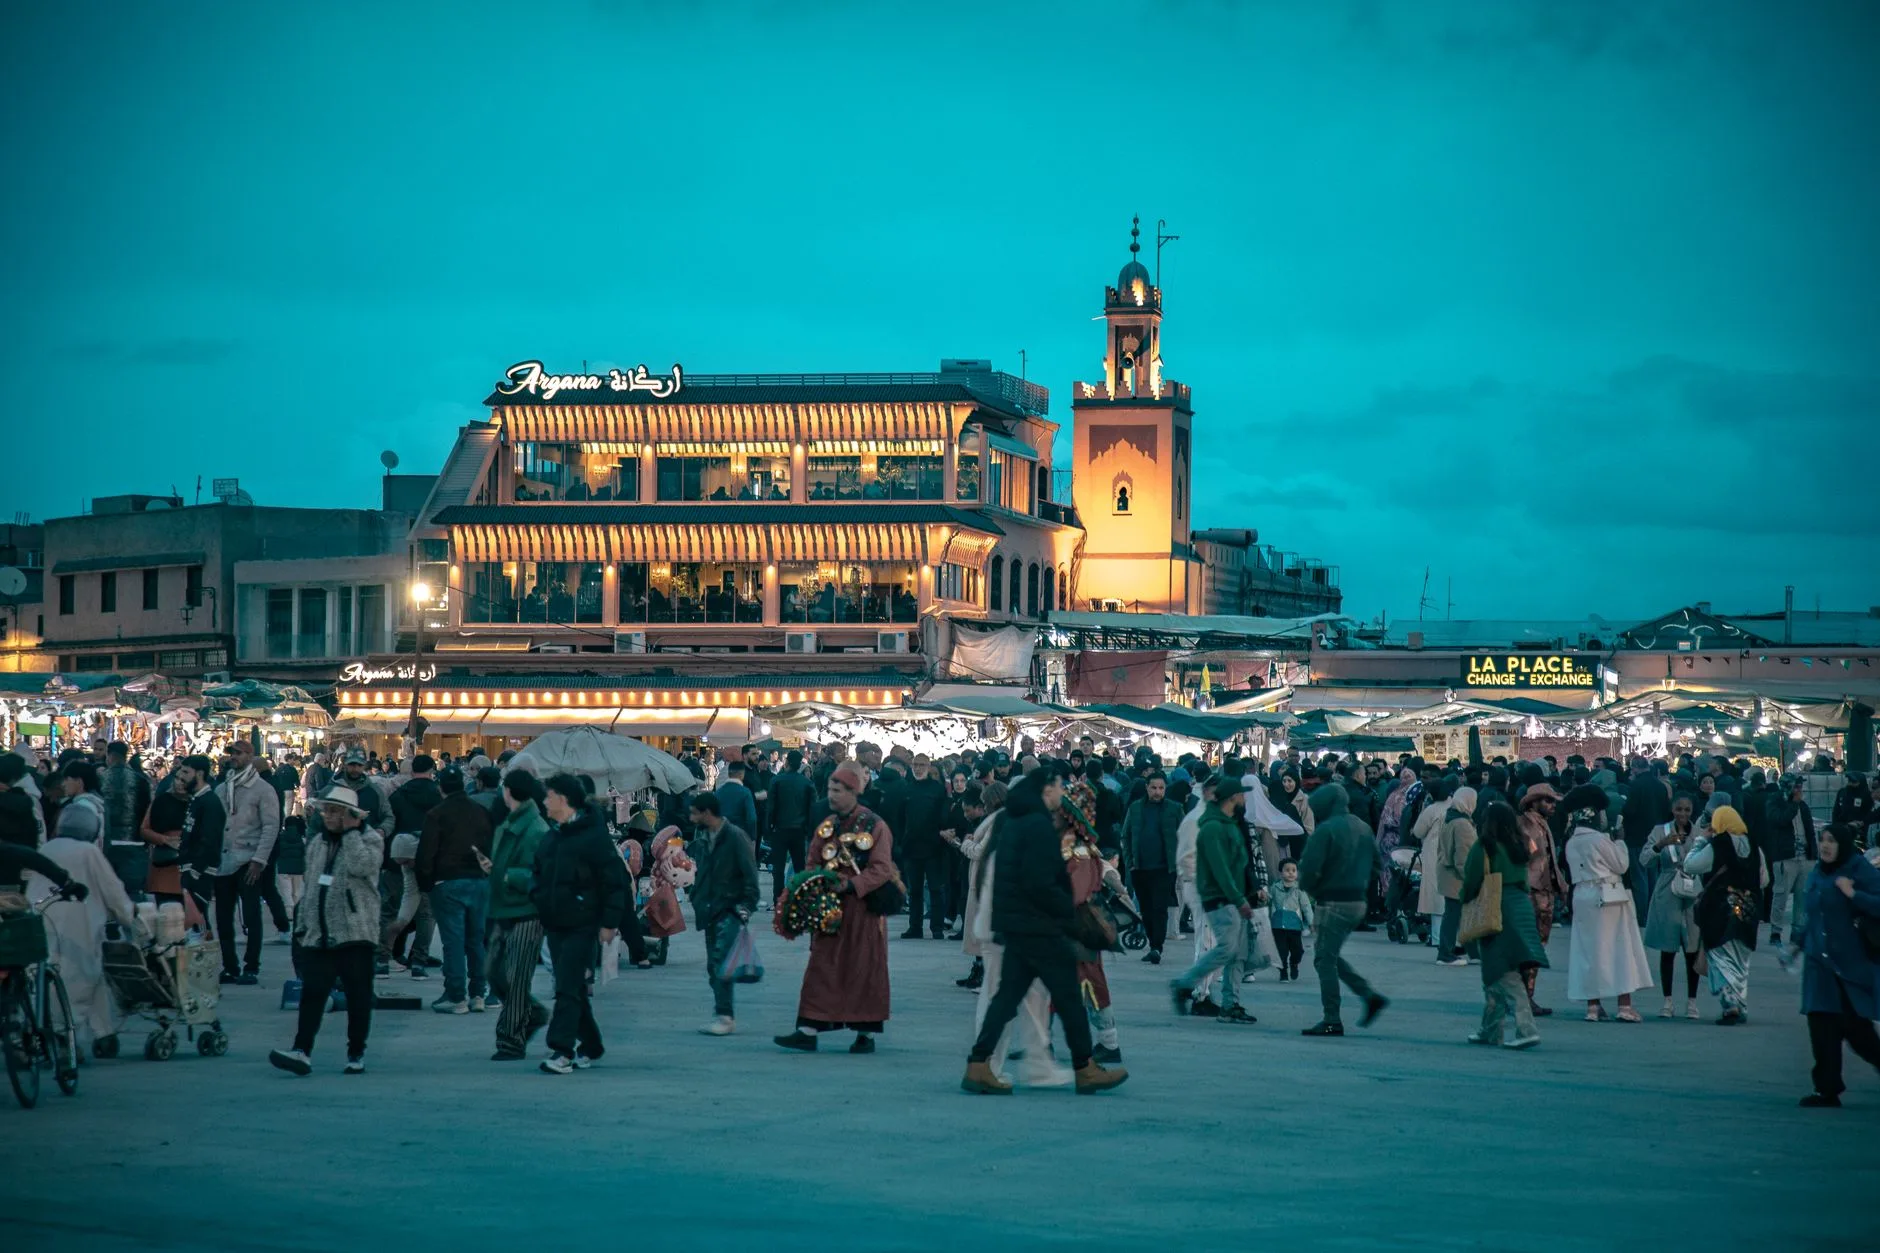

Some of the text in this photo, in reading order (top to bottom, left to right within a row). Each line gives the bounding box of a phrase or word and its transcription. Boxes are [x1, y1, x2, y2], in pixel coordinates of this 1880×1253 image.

[498, 362, 602, 400] Argana
[339, 662, 395, 684] Argana
[1471, 656, 1497, 673] LA
[1507, 656, 1573, 673] PLACE
[1467, 673, 1516, 685] CHANGE
[1529, 673, 1593, 685] EXCHANGE
